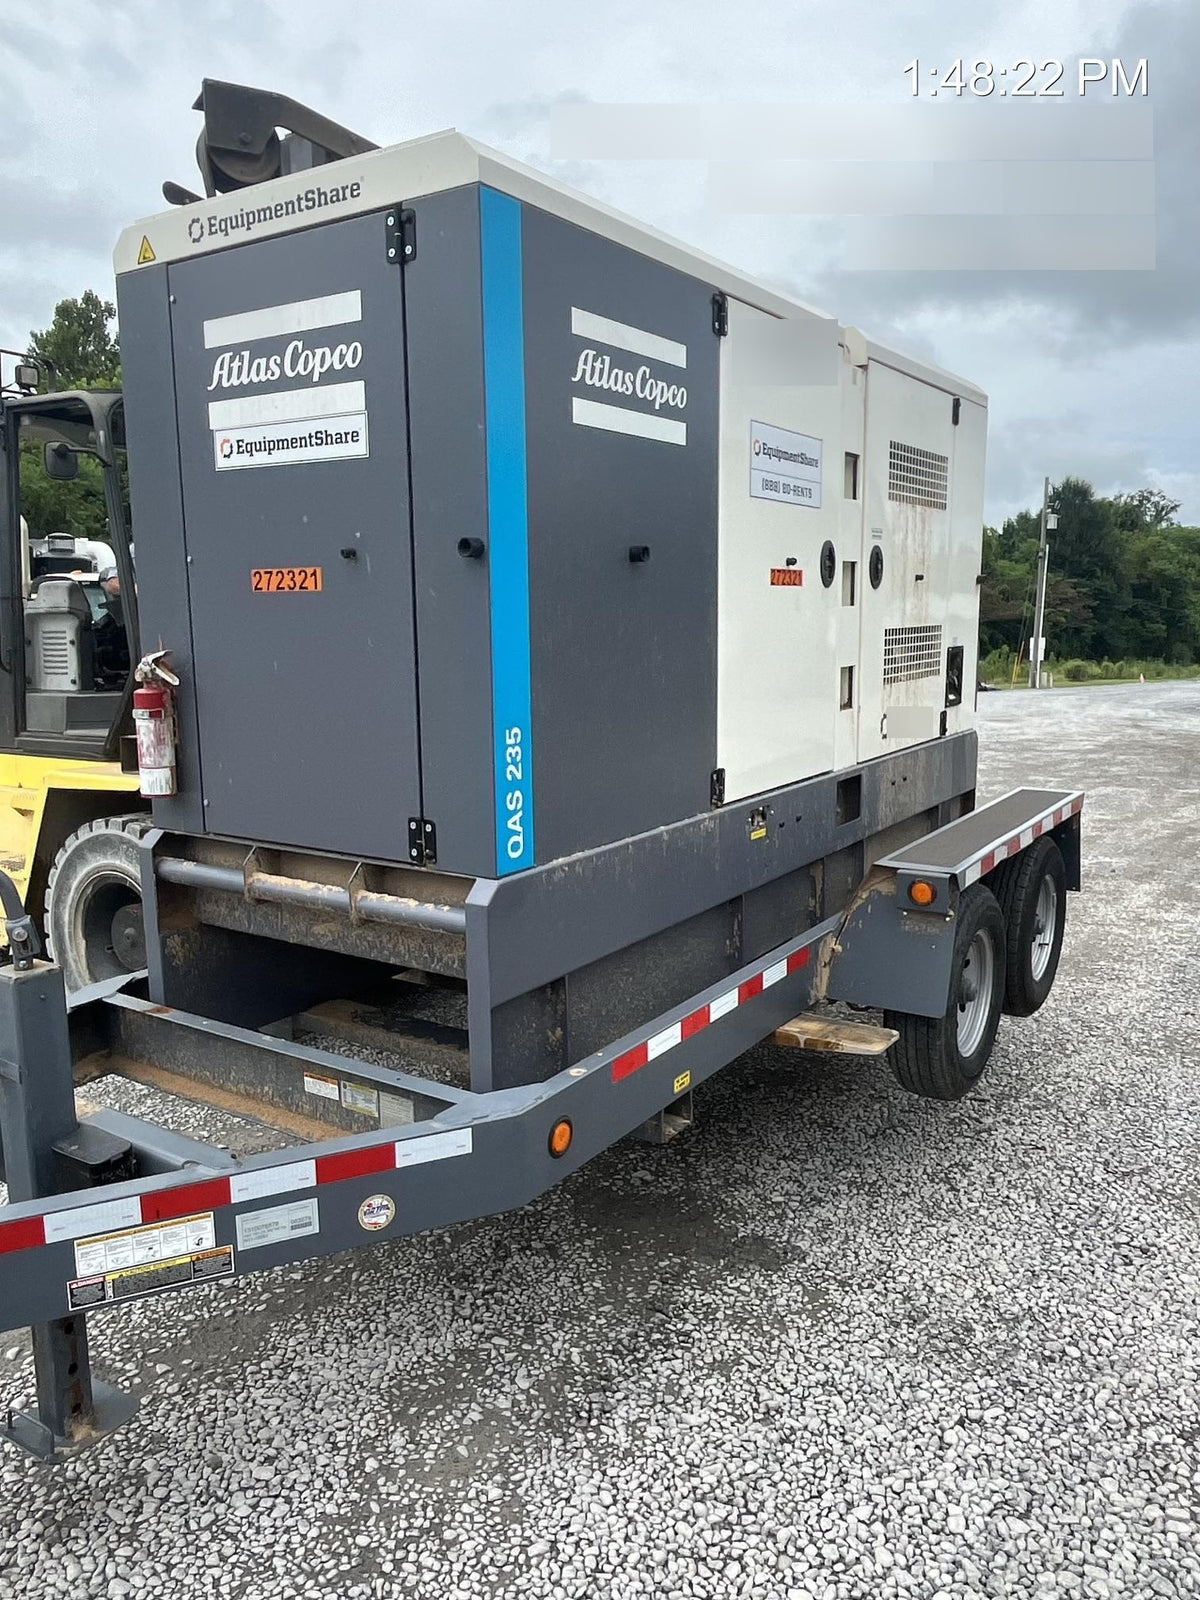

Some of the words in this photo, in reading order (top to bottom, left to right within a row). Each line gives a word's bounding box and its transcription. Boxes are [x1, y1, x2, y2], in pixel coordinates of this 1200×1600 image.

[207, 180, 361, 237] EquipmentShare
[207, 350, 281, 391] Atlas
[283, 340, 363, 382] Copco
[571, 349, 634, 395] Atlas
[635, 365, 688, 410] Copco
[236, 429, 360, 456] EquipmentShare
[762, 442, 819, 468] EquipmentShare
[253, 568, 318, 591] 272321
[770, 568, 801, 586] 272321
[506, 726, 522, 781] 235
[506, 789, 524, 859] QAS
